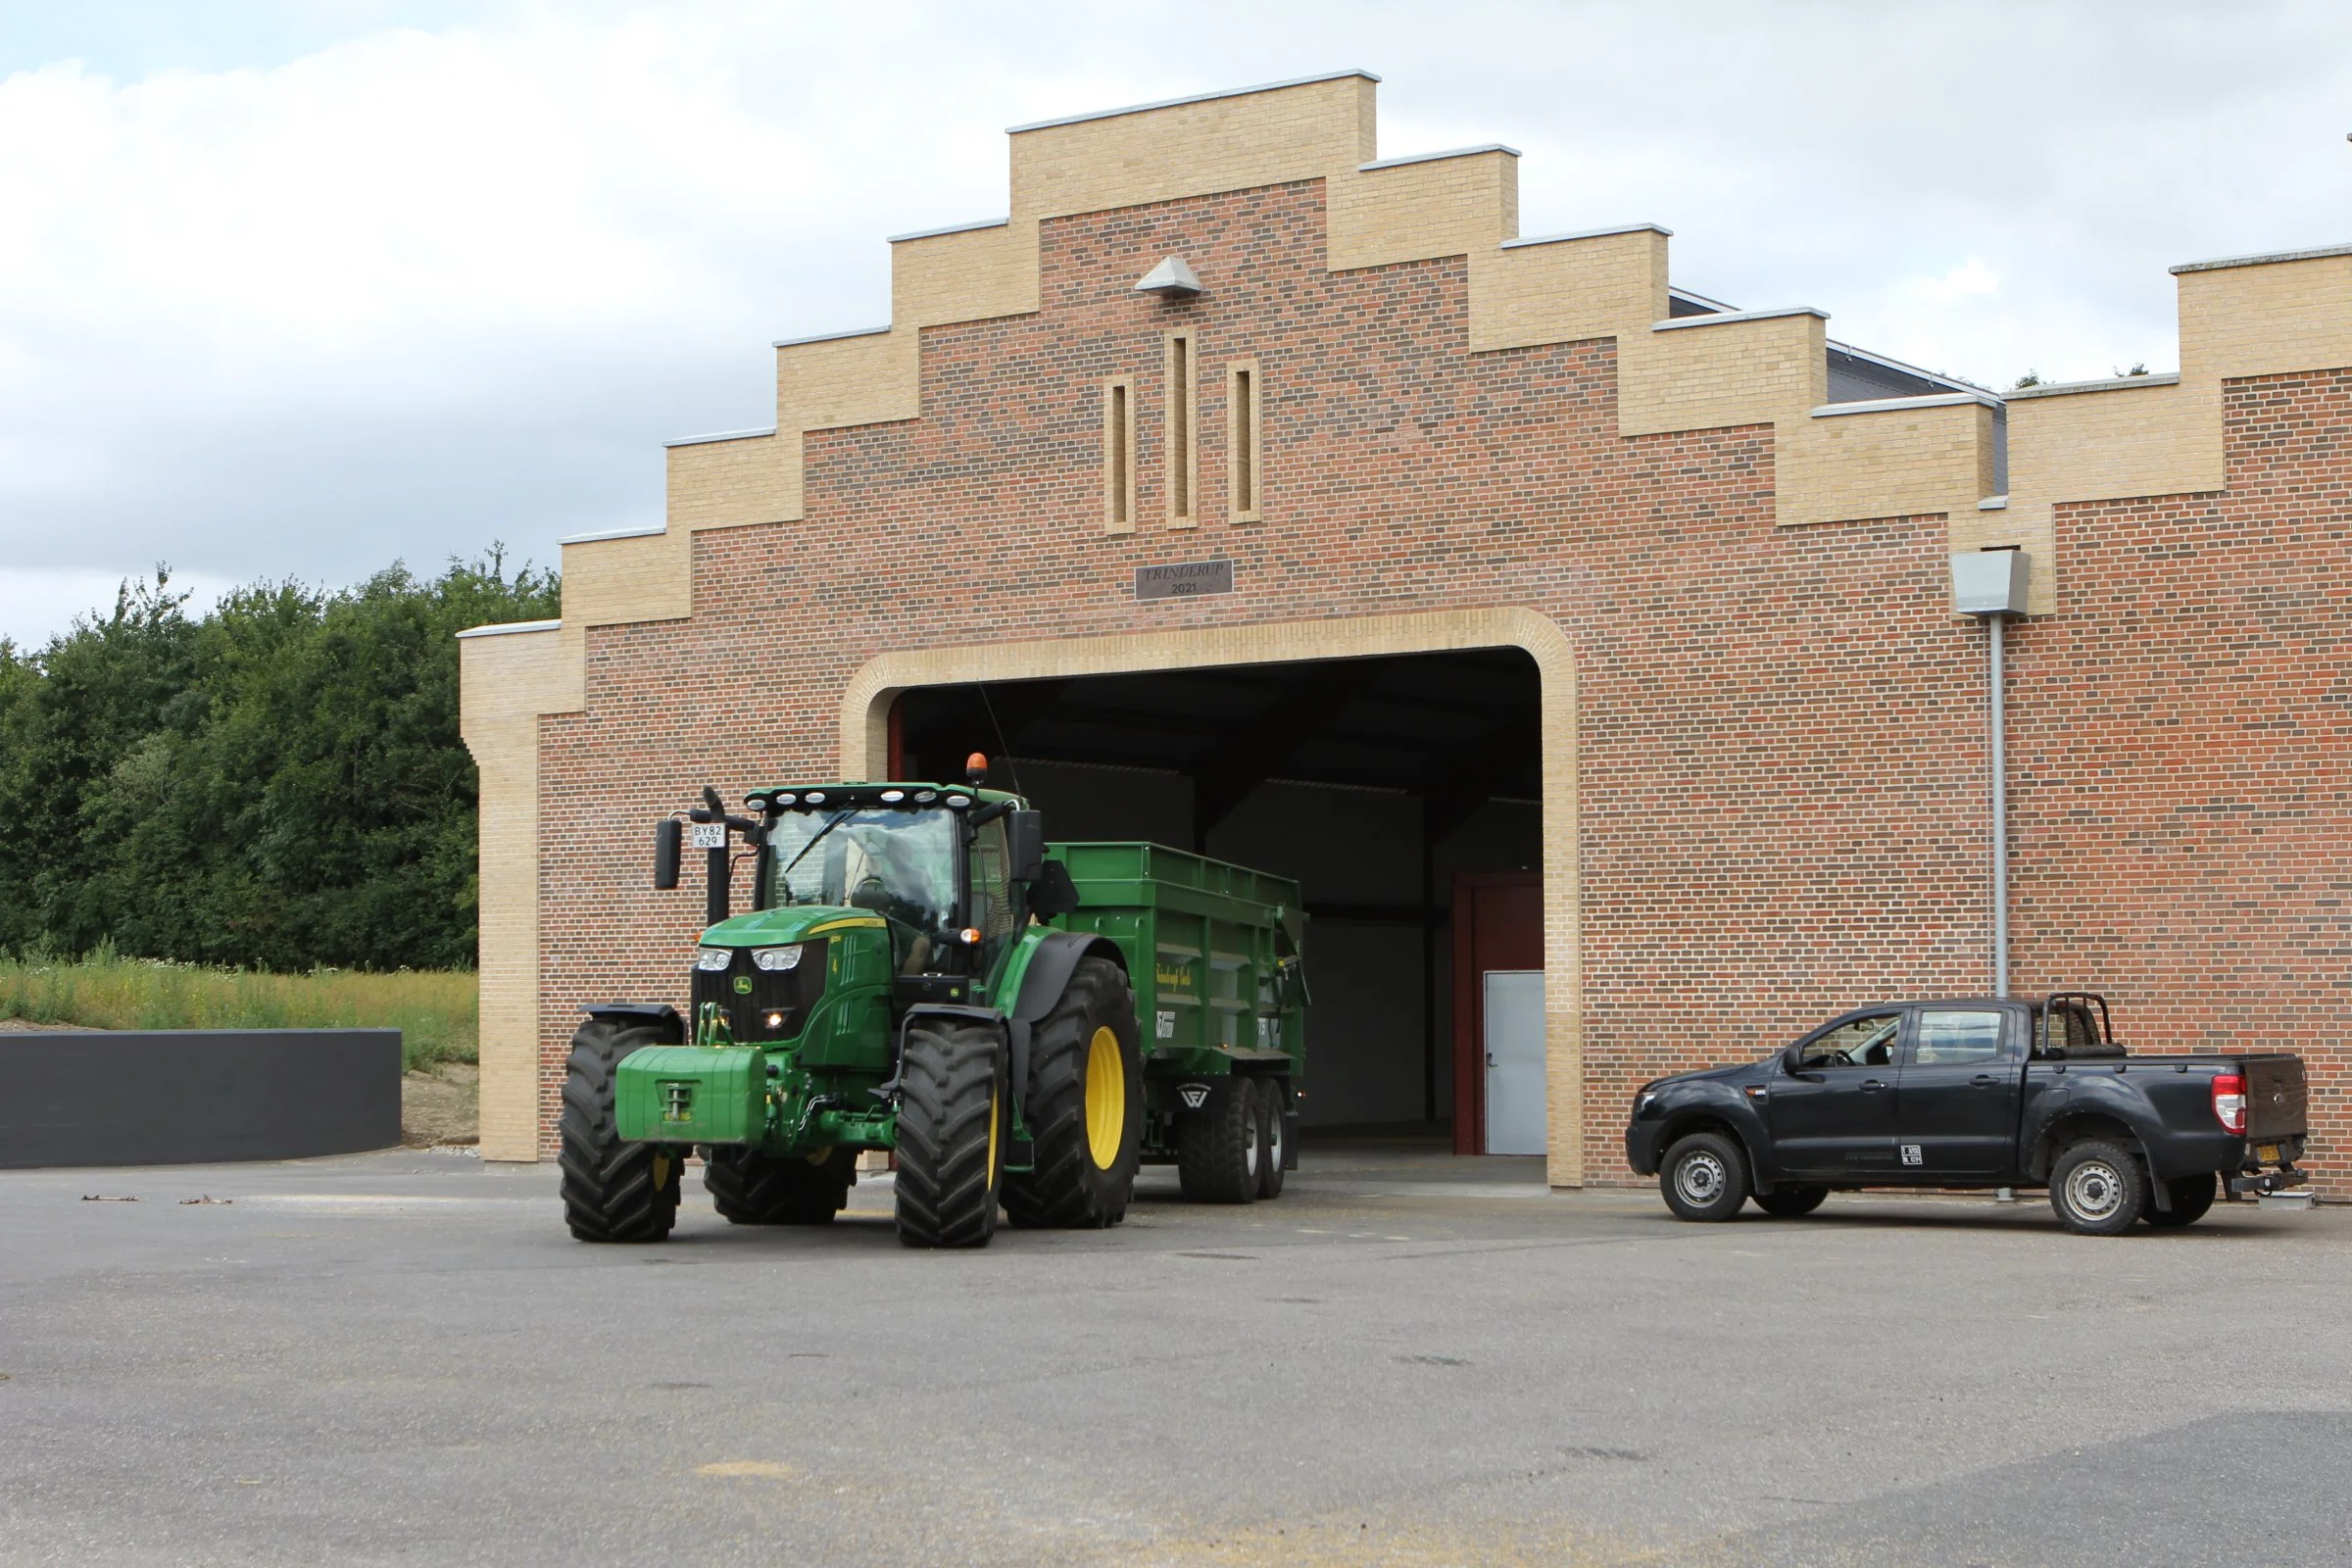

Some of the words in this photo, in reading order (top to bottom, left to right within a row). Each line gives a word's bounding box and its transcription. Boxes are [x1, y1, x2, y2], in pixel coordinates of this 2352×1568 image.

[1145, 564, 1224, 581] TRINDERUP
[1171, 583, 1198, 594] 2021
[694, 825, 722, 836] BY82
[698, 836, 717, 846] 629
